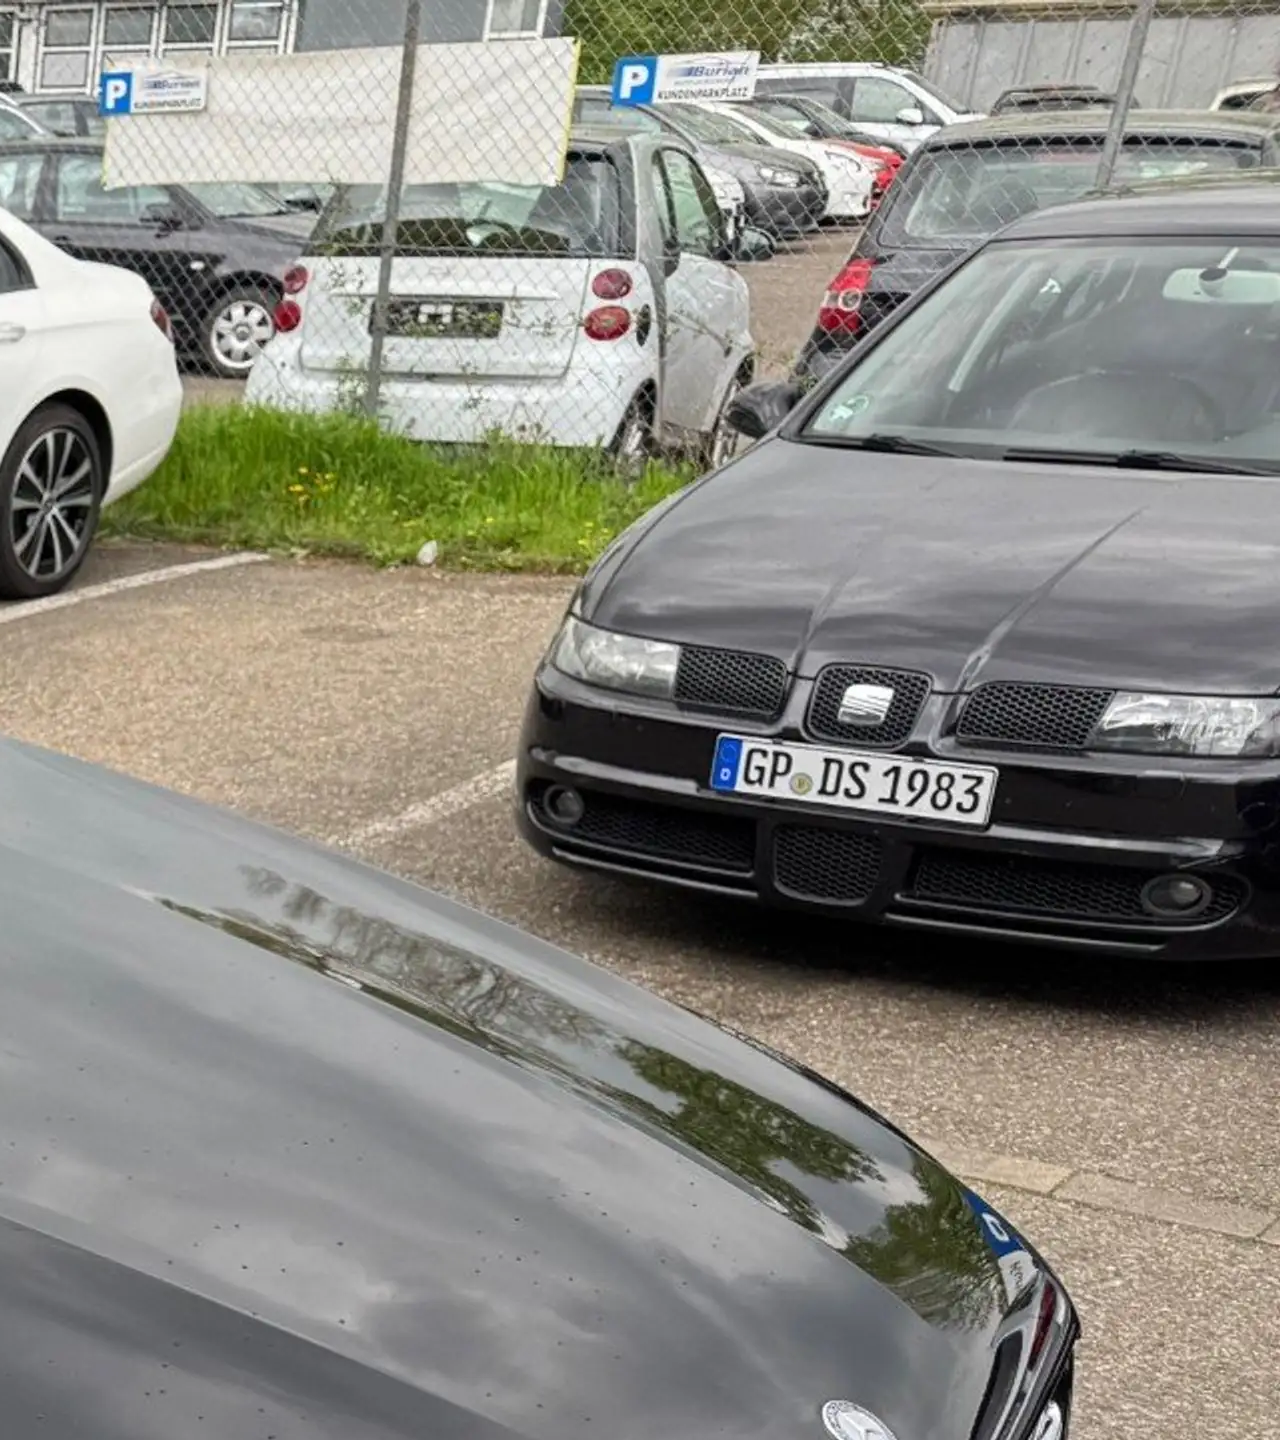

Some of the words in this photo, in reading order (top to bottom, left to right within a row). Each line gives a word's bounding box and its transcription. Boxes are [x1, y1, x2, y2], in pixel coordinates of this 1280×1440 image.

[105, 79, 128, 109] P
[619, 65, 649, 99] P
[743, 748, 793, 789] GP
[817, 757, 871, 806] DS
[878, 765, 984, 814] 1983
